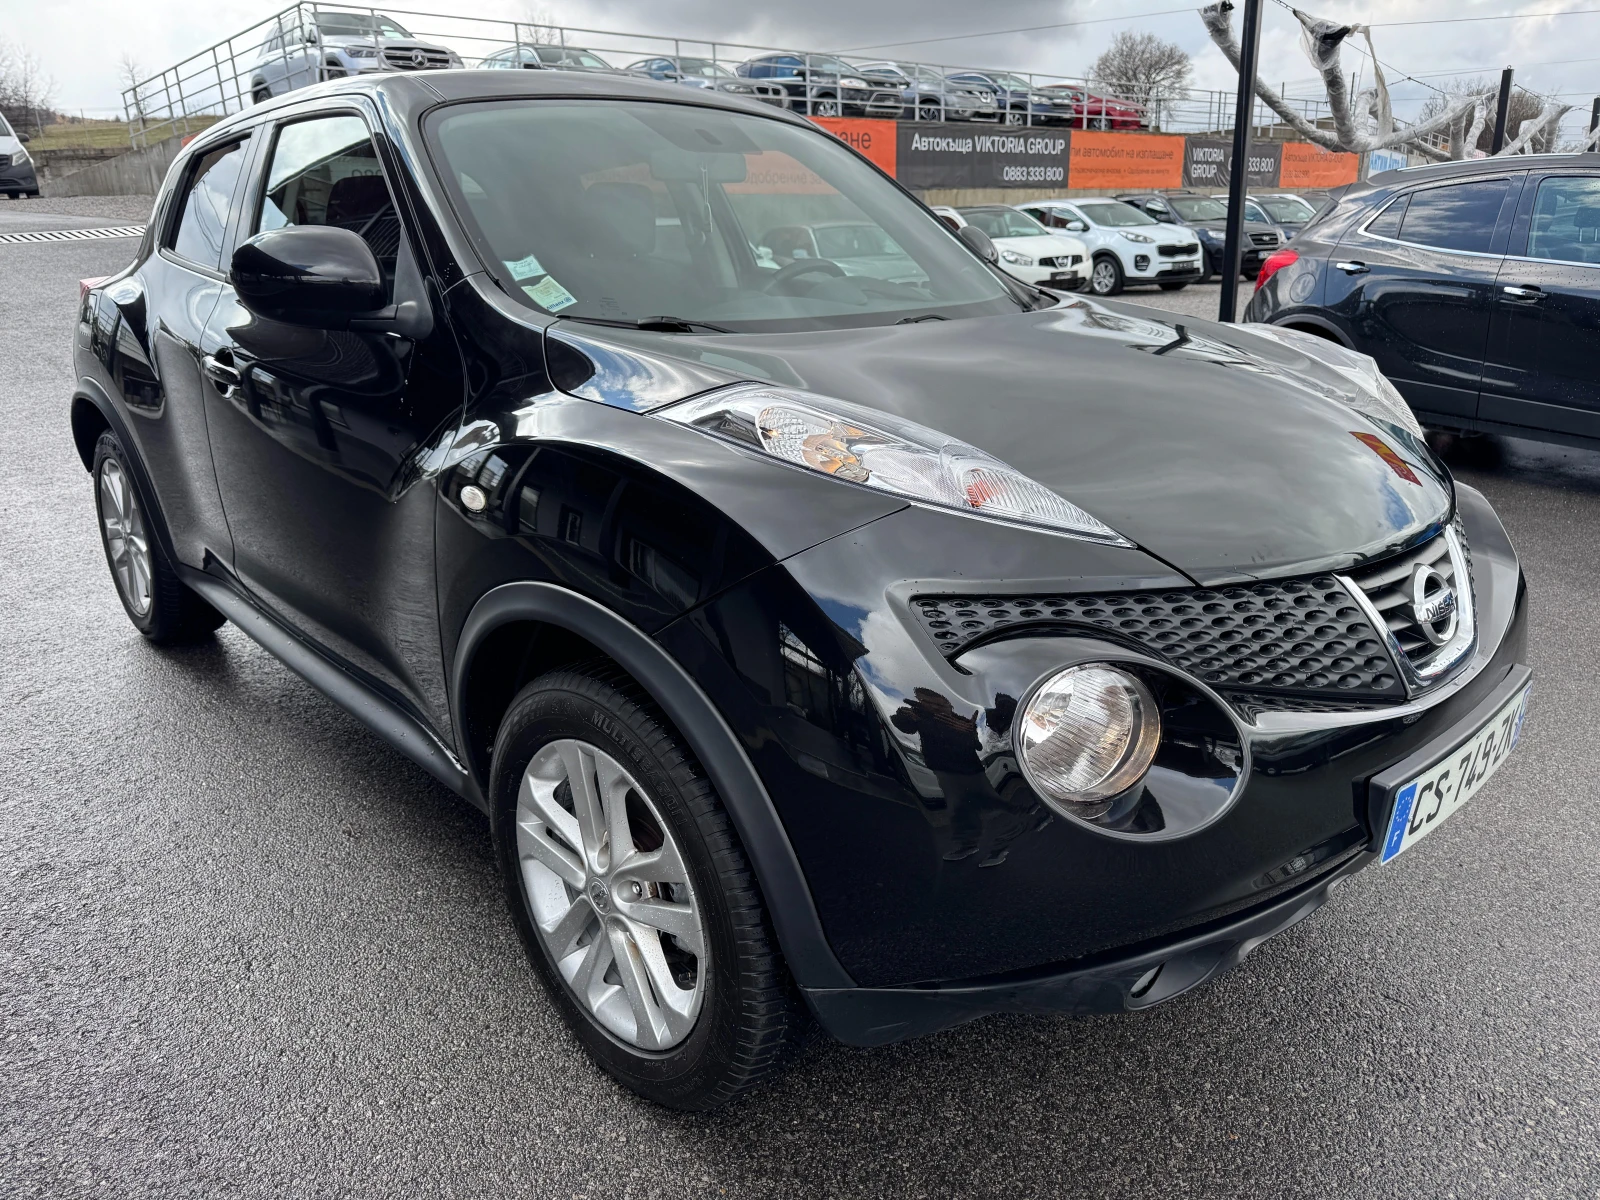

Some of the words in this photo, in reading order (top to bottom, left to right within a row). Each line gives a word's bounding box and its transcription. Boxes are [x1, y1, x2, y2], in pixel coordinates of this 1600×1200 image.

[834, 131, 872, 150] ане
[911, 132, 973, 154] Автокъща
[974, 135, 1026, 155] VIKTORIA
[1026, 137, 1066, 155] GROUP
[1192, 147, 1225, 162] VIKTORIA
[1191, 163, 1218, 178] GROUP
[1248, 157, 1260, 172] 333
[1260, 157, 1275, 172] 800
[746, 170, 807, 186] добрение
[1003, 166, 1027, 181] 0883
[1027, 166, 1045, 181] 333
[1045, 166, 1064, 181] 800
[1408, 703, 1521, 836] CS-749-ZK
[1391, 829, 1401, 848] F
